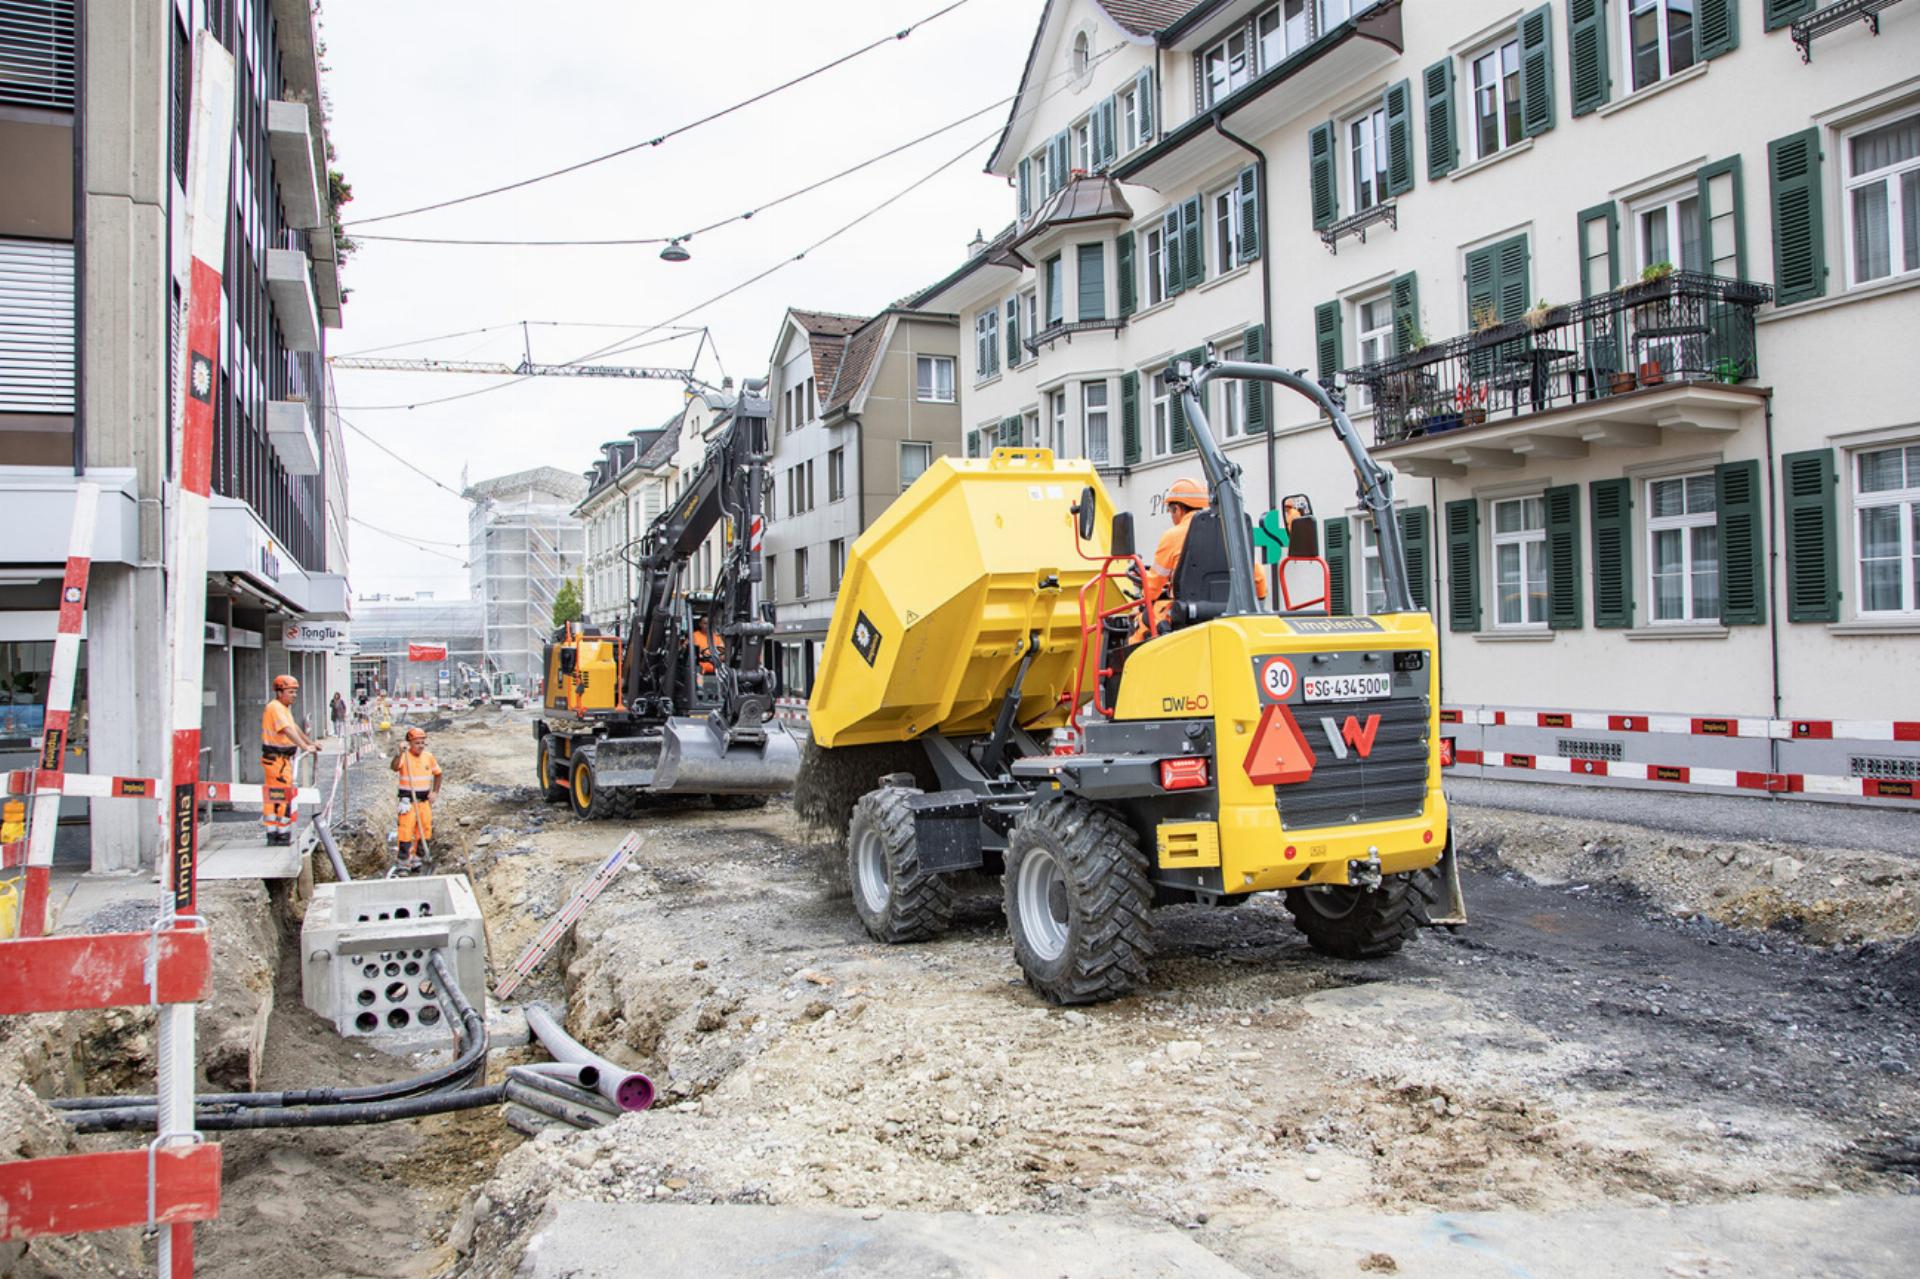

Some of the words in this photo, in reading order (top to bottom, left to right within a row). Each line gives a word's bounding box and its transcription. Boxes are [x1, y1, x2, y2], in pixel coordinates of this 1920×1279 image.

[1295, 617, 1374, 633] Implenia
[1270, 669, 1290, 689] 30
[1162, 694, 1209, 712] DW60
[176, 794, 194, 902] Implenia
